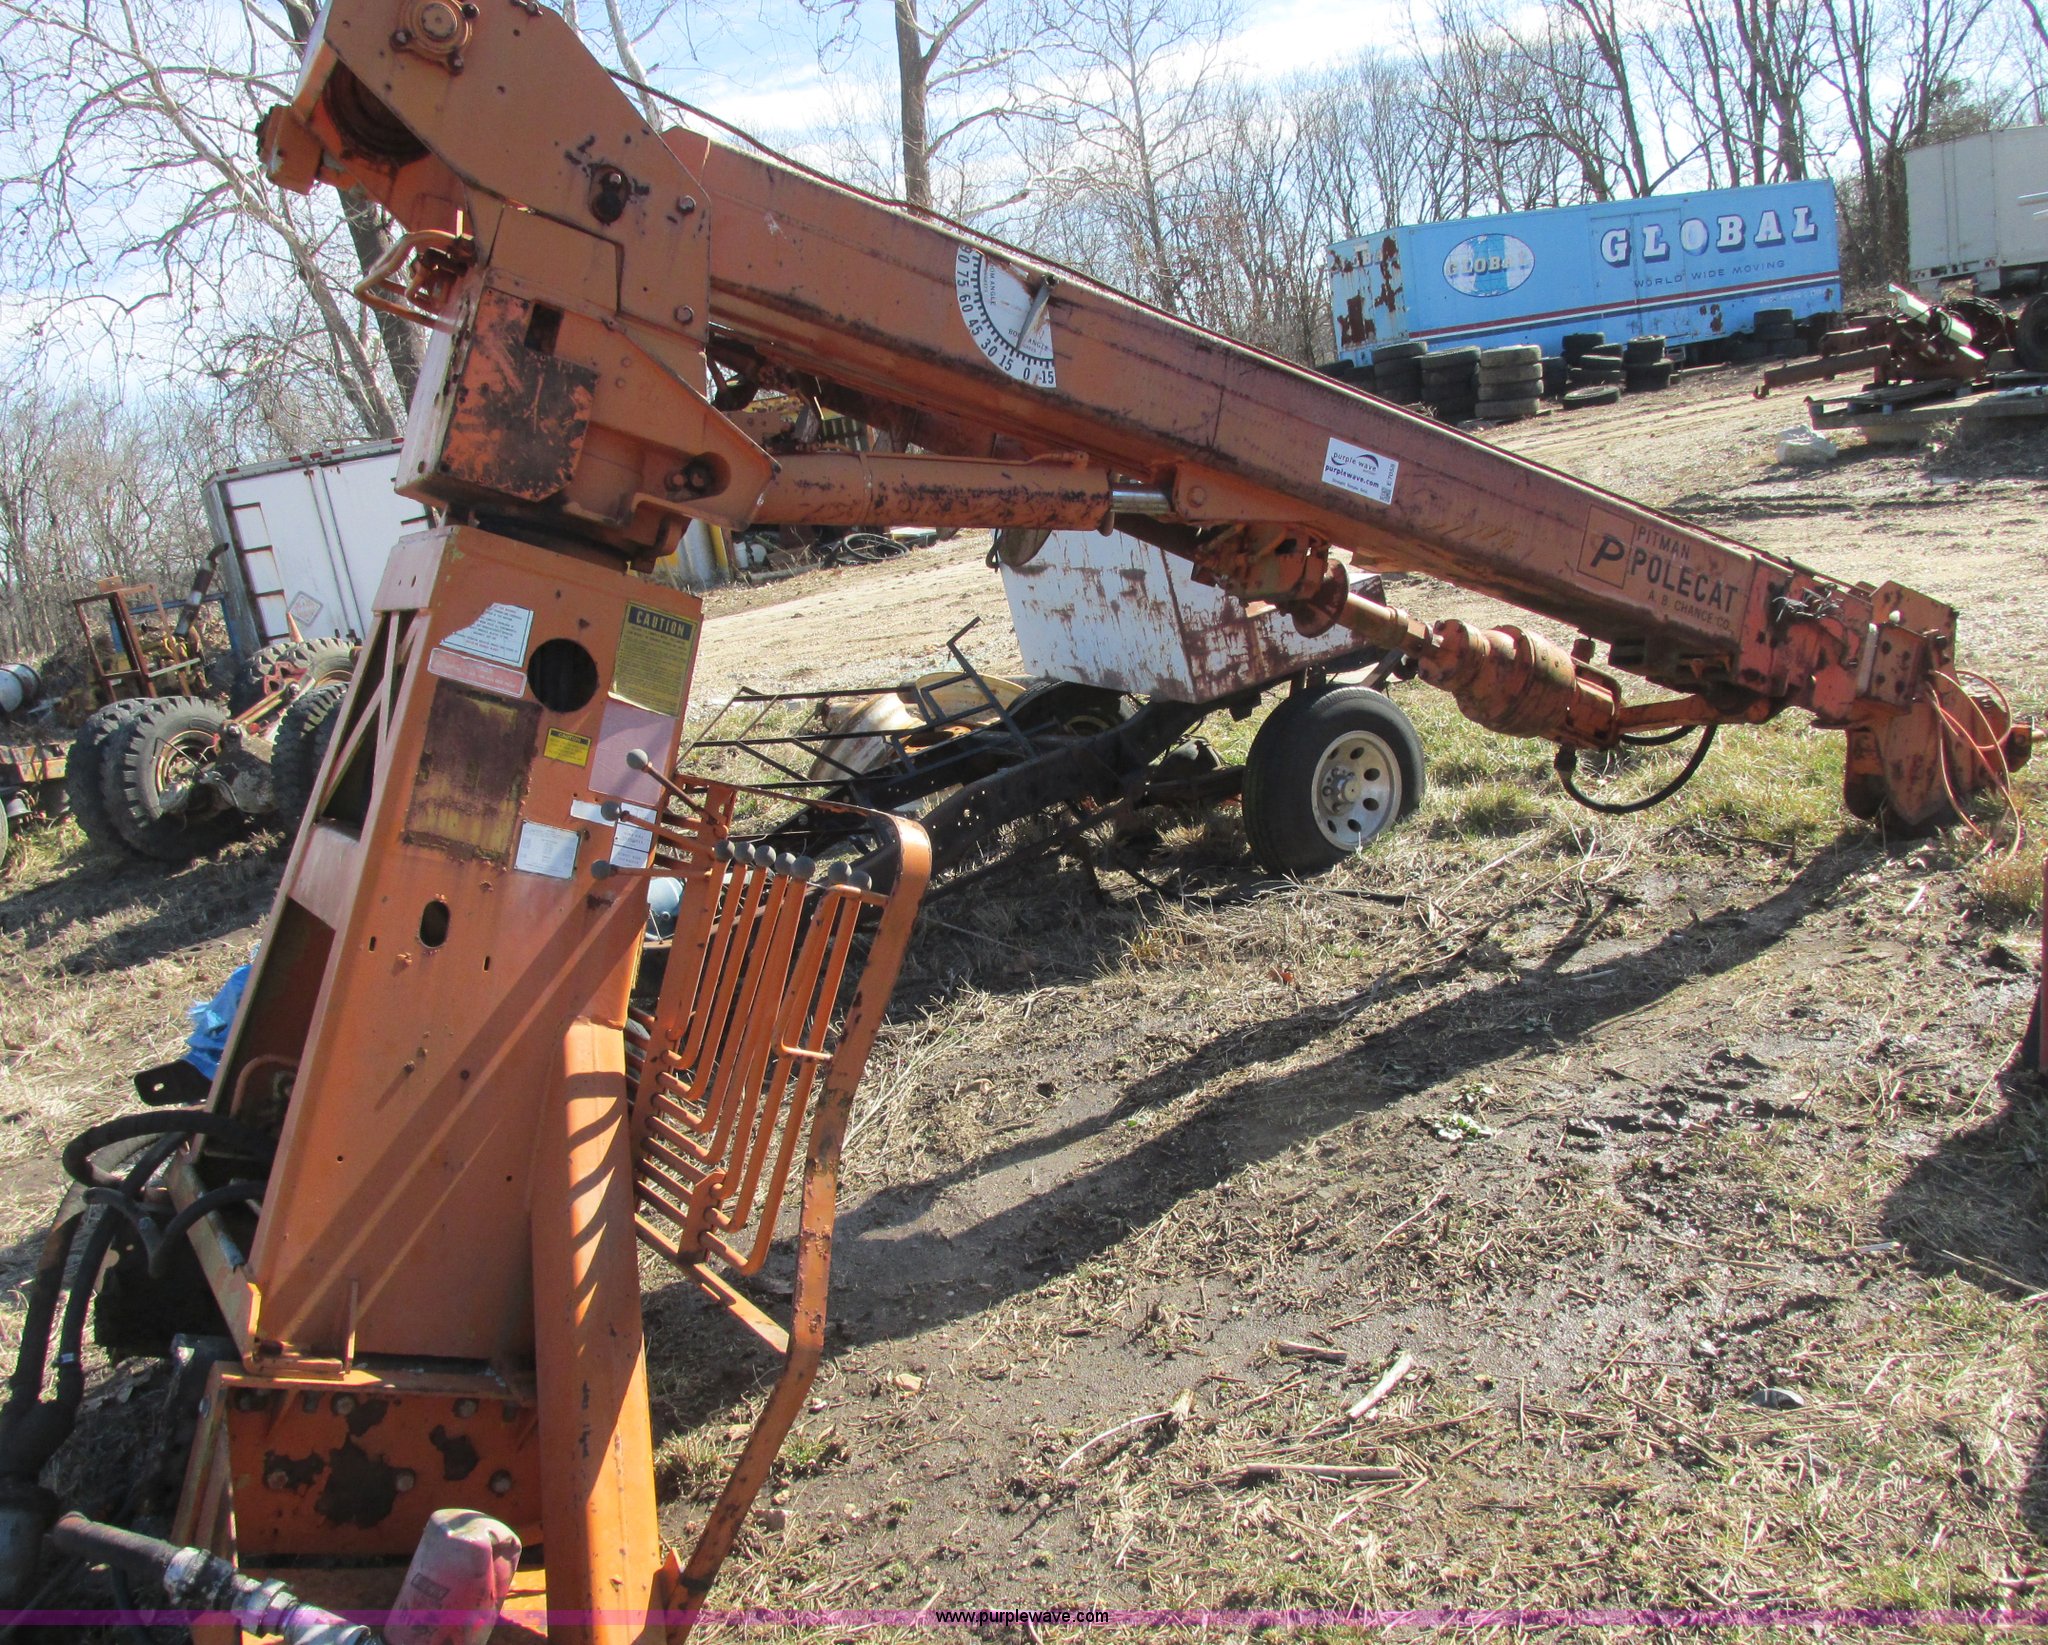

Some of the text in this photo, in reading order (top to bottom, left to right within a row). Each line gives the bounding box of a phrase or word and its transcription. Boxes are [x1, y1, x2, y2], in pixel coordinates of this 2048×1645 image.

[1601, 206, 1818, 268] GLOBAL
[957, 245, 972, 264] 90
[1446, 250, 1530, 279] GLOBAL
[957, 271, 969, 288] 75
[1634, 259, 1786, 288] WORLD WIDE MOVING
[959, 294, 974, 313] 60
[968, 319, 984, 336] 45
[981, 338, 998, 358] 30
[998, 355, 1014, 372] 15
[1023, 367, 1030, 381] 0
[1039, 370, 1054, 385] -15
[1333, 452, 1377, 472] purple wave
[1324, 464, 1380, 489] purplewave.com
[1590, 533, 1625, 568] P
[1637, 525, 1690, 560] PITMAN
[1630, 548, 1738, 613] POLECAT
[1673, 600, 1713, 624] CHANCE
[636, 610, 685, 637] CAUTION
